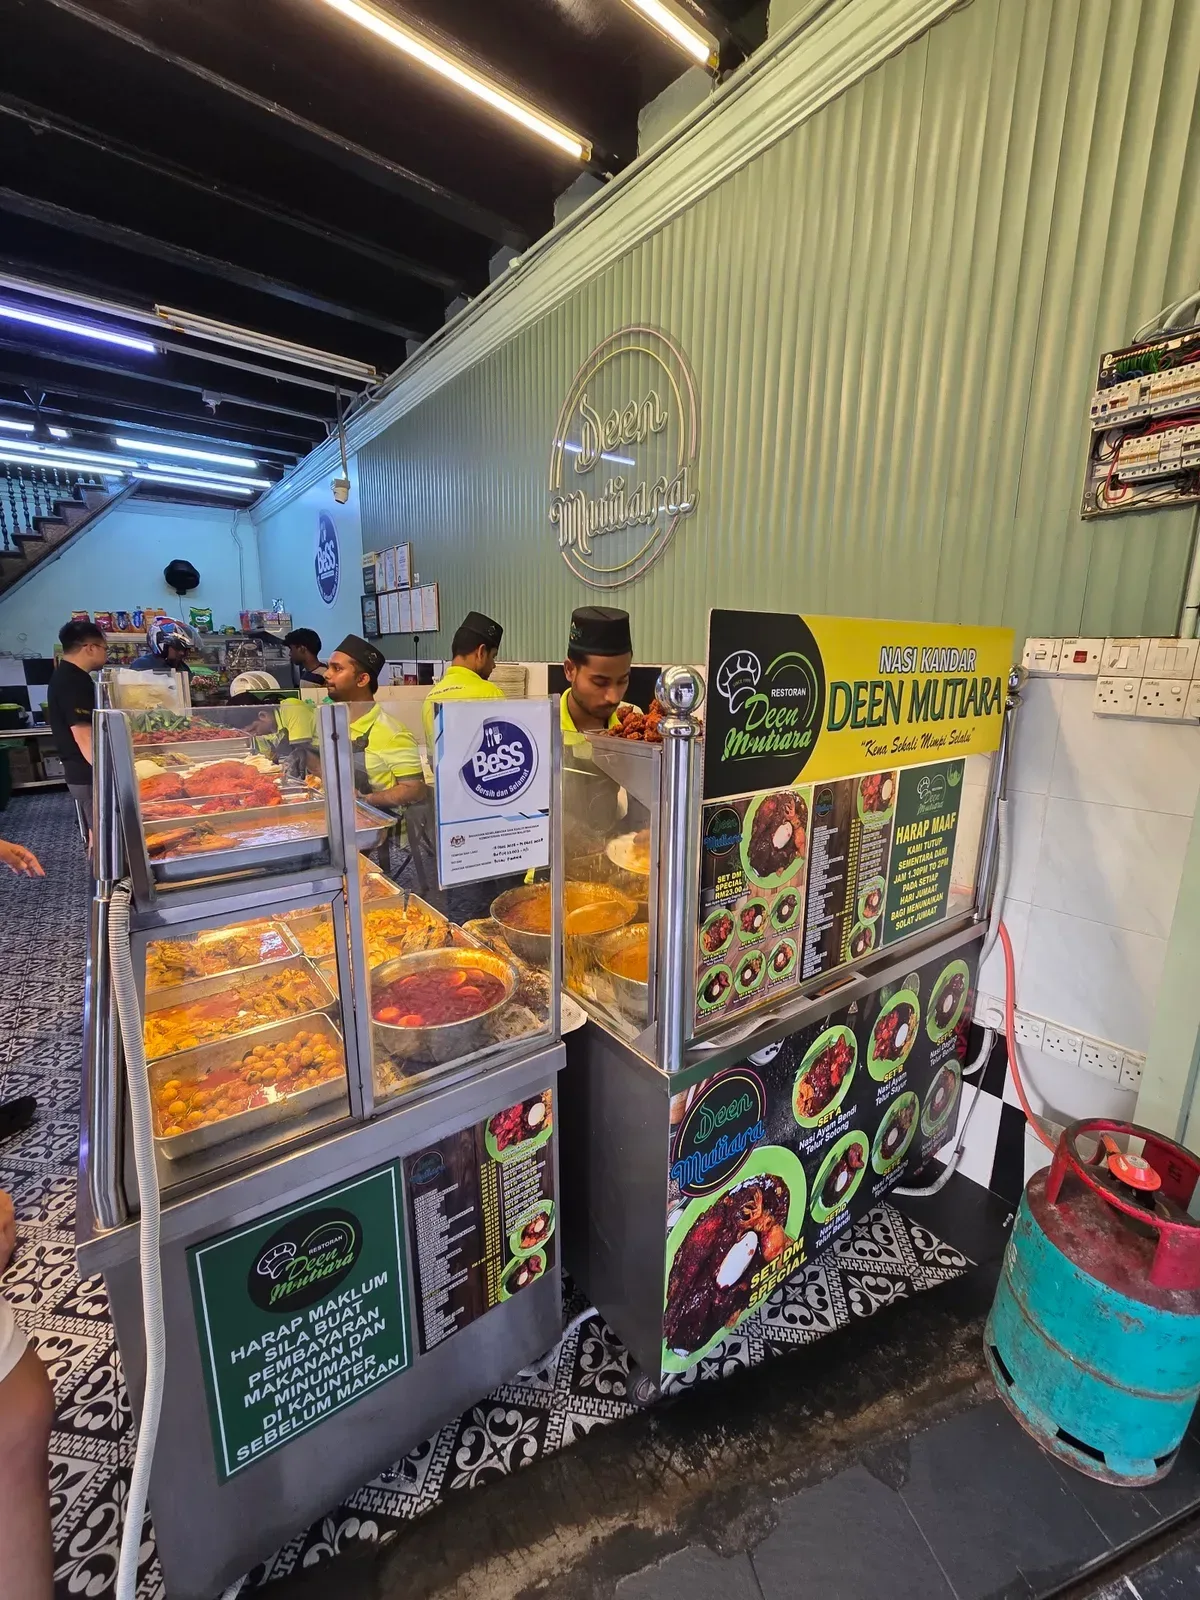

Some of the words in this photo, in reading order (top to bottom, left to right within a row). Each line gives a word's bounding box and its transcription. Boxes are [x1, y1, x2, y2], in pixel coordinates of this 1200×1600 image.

[574, 390, 668, 474] Deen
[549, 467, 696, 555] Mutiara
[879, 646, 917, 673] NASI
[920, 647, 977, 673] KANDAR
[771, 687, 806, 698] RESTORAN
[827, 680, 903, 731] DEEN
[907, 677, 1002, 722] MUTIARA
[745, 693, 798, 731] Deen
[472, 741, 525, 778] BeSS
[721, 728, 811, 761] Mutiara
[891, 735, 917, 754] Sekali
[920, 734, 946, 751] Mimpi
[475, 784, 495, 797] Bersih
[496, 789, 508, 797] dan
[509, 769, 529, 792] Selamat
[896, 820, 929, 845] HARAP
[931, 812, 957, 835] MAAF
[898, 853, 933, 870] SEMENTARA
[934, 847, 947, 859] DARI
[907, 844, 923, 855] KAMI
[924, 837, 943, 851] TUTUP
[715, 879, 742, 892] SPECIAL
[717, 874, 729, 884] SET
[731, 871, 742, 880] DM
[893, 873, 907, 884] JAM
[937, 858, 949, 868] 2PM
[902, 882, 918, 893] PADA
[919, 873, 939, 886] SETIAP
[715, 886, 742, 900] RM23.00
[891, 909, 905, 921] BAGI
[906, 893, 943, 916] MENUNAIKAN
[900, 894, 915, 905] HARI
[915, 884, 938, 898] JUMAAT
[896, 916, 914, 930] SOLAT
[915, 906, 937, 922] JUMAAT
[884, 1069, 896, 1083] SET
[693, 1093, 753, 1144] Deen
[799, 1132, 816, 1151] Nasi
[816, 1121, 836, 1139] Ayam
[837, 1104, 857, 1124] Bendi
[818, 1110, 835, 1127] SET
[835, 1106, 842, 1116] A
[670, 1120, 766, 1189] Mutiara
[806, 1138, 824, 1155] Telur
[825, 1121, 849, 1142] Sotong
[816, 1231, 831, 1248] Telur
[832, 1214, 851, 1234] Bendi
[820, 1220, 834, 1237] Nasi
[835, 1210, 849, 1225] Ikan
[825, 1209, 840, 1225] SET
[309, 1235, 343, 1255] RESTORAN
[269, 1252, 354, 1305] Mutiara
[285, 1247, 338, 1280] Deen
[750, 1257, 780, 1288] SET
[783, 1236, 804, 1262] DM
[748, 1254, 808, 1308] SPECIAL
[231, 1317, 303, 1364] HARAP
[309, 1271, 388, 1323] MAKLUM
[265, 1329, 309, 1362] SILA
[314, 1300, 363, 1335] BUAT
[244, 1341, 343, 1408] MAKANAN
[350, 1318, 386, 1346] DAN
[249, 1307, 380, 1388] PEMBAYARAN
[263, 1411, 282, 1430] DI
[288, 1355, 376, 1420] KAUNTER
[274, 1346, 364, 1408] MINUMAN
[237, 1397, 331, 1462] SEBELUM
[337, 1354, 399, 1402] MAKAN
